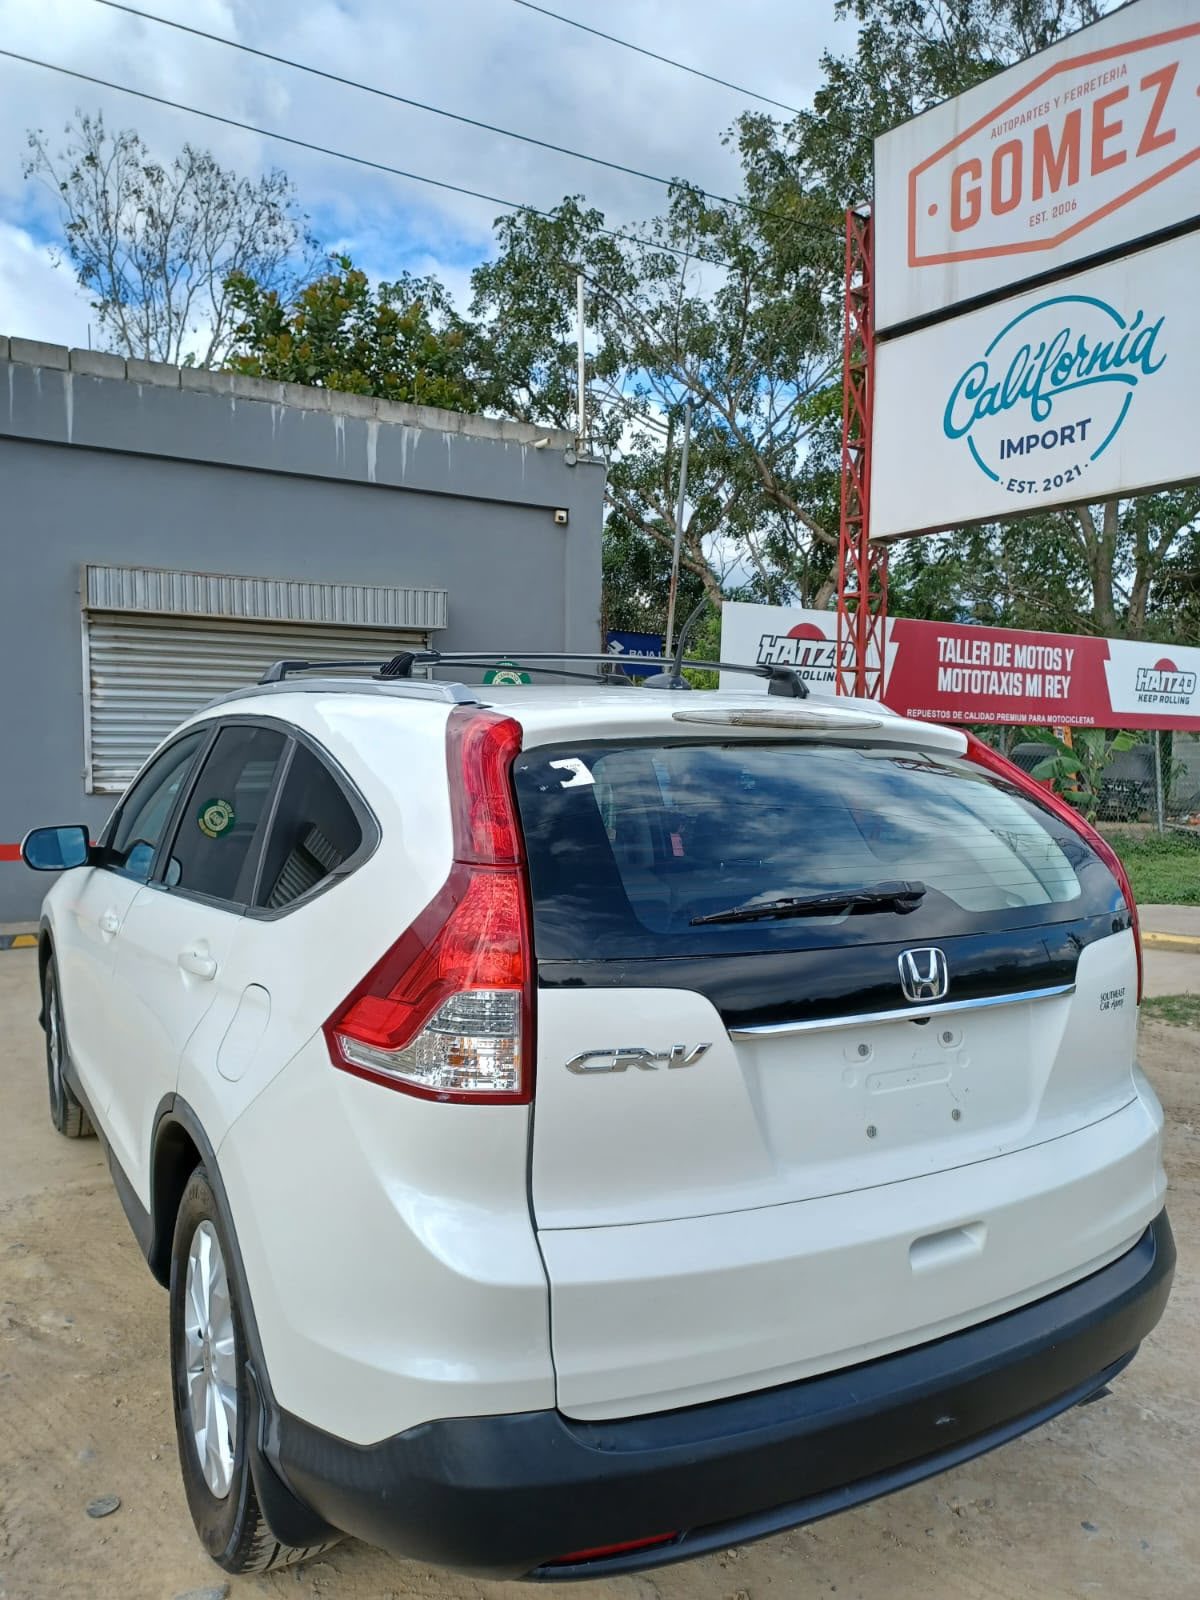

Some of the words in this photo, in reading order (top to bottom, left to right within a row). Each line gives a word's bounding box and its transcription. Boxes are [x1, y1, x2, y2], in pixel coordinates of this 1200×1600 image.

[990, 101, 1050, 140] AUTOPARTES
[1053, 97, 1061, 108] Y
[1063, 63, 1128, 104] FERRETERIA
[950, 61, 1179, 232] GOMEZ
[1029, 211, 1048, 227] EST.
[1052, 199, 1078, 218] 2006
[943, 310, 1167, 439] California
[1000, 418, 1092, 460] IMPORT
[1006, 478, 1039, 494] EST.
[1043, 464, 1082, 492] 2021
[937, 637, 991, 666] TALLER
[993, 642, 1012, 667] DE
[1014, 644, 1063, 671] MOTOS
[1065, 648, 1075, 672] Y
[797, 670, 837, 682] OLLIN
[937, 666, 1023, 697] MOTOTAXIS
[1025, 673, 1042, 698] MI
[1045, 674, 1072, 699] REY
[1137, 693, 1158, 704] KEEP
[1159, 695, 1190, 705] ROLLING
[906, 708, 951, 719] REPUESTOS
[952, 711, 963, 719] DE
[964, 711, 995, 721] CALIDAD
[996, 713, 1027, 722] PREMIUM
[1028, 715, 1046, 723] PARA
[1047, 715, 1095, 725] MOTOCICLETAS
[565, 1042, 712, 1075] CR-V
